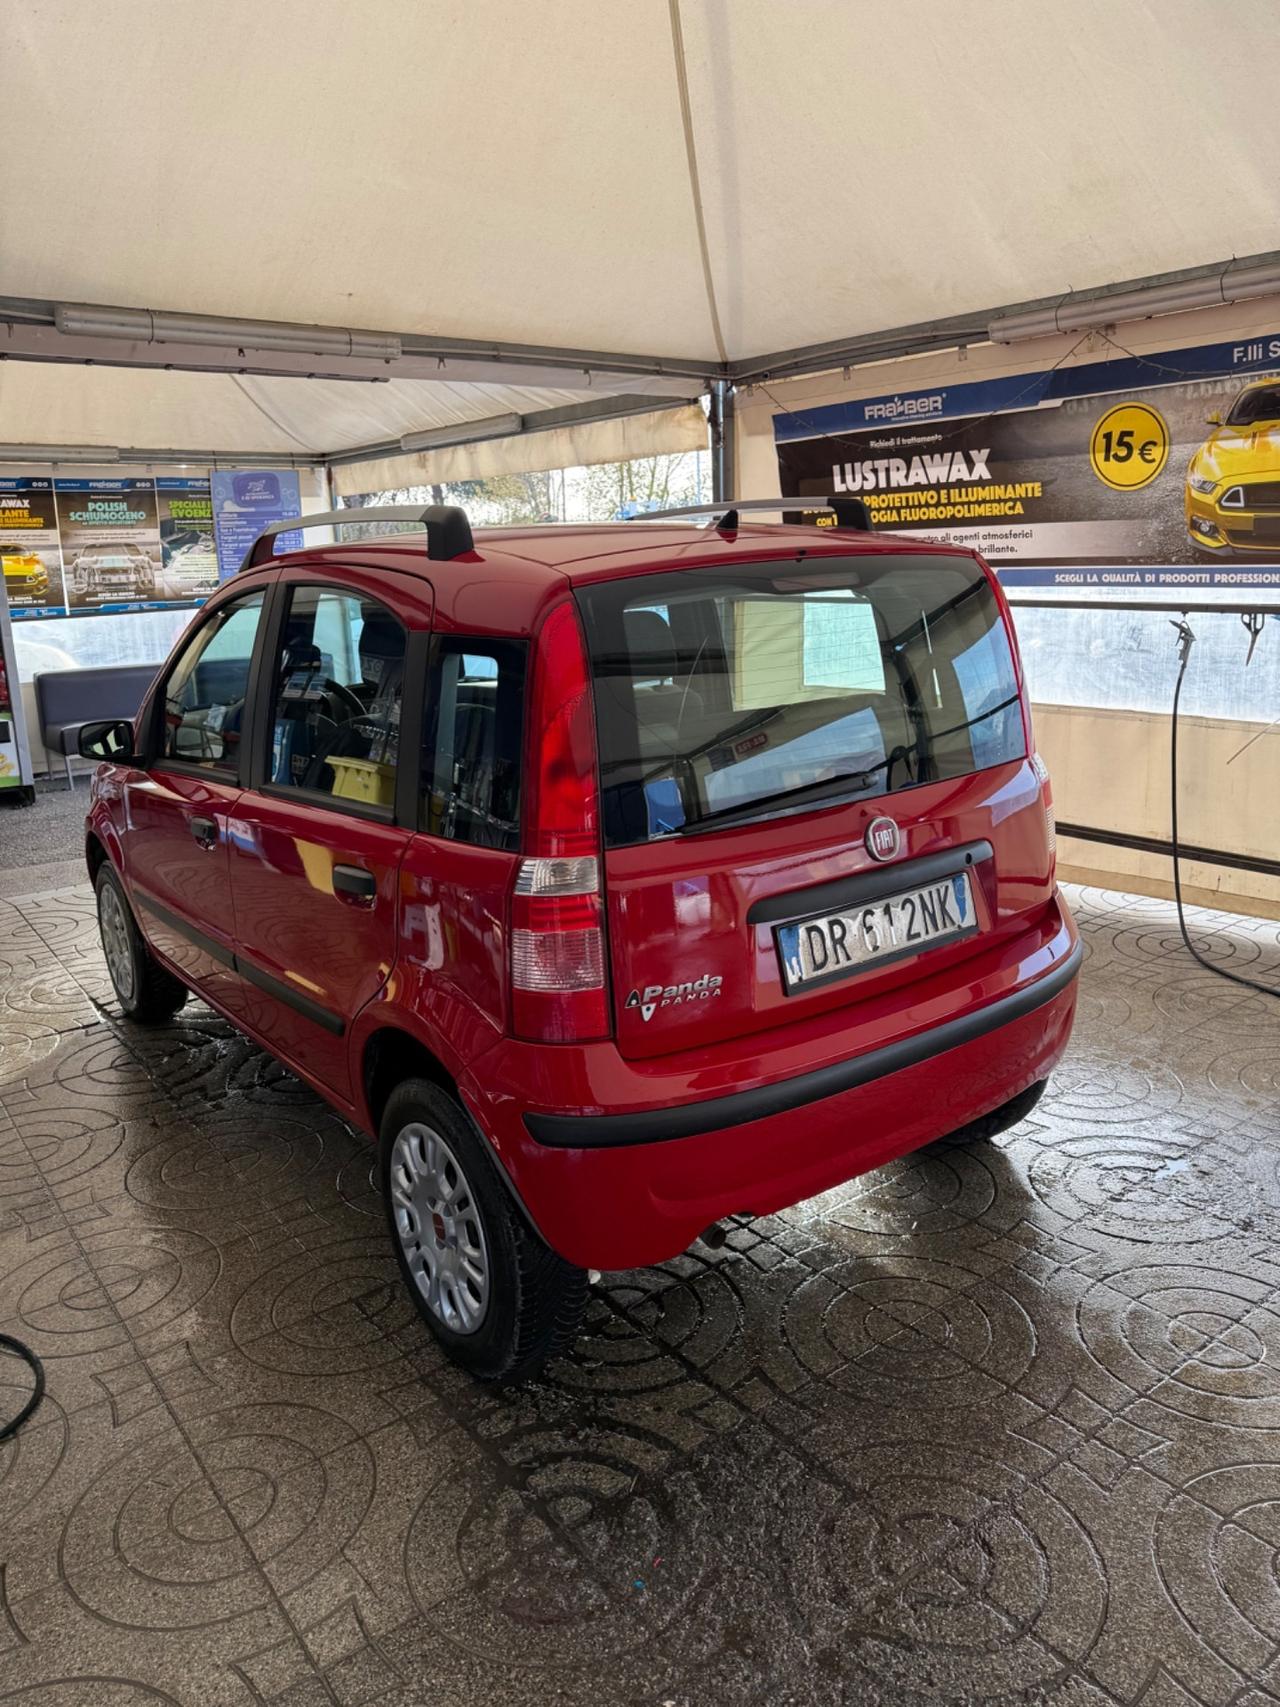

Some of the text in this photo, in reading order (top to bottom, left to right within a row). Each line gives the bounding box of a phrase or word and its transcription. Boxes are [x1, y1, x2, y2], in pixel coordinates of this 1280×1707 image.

[1233, 343, 1263, 363] F.lli
[902, 433, 943, 445] trattamento
[832, 448, 992, 493] LUSTRAWAX
[941, 490, 949, 503] E
[950, 482, 1042, 503] ILLUMINANTE
[69, 510, 147, 521] SCHIUMOGENO
[87, 501, 128, 512] POLISH
[901, 501, 1025, 521] FLUOROPOLIMERICA
[952, 531, 980, 543] agenti
[982, 529, 1033, 540] atmosferici
[978, 544, 1018, 554] brillante.
[1055, 573, 1084, 583] SCEGLI
[1087, 573, 1099, 583] LA
[1102, 571, 1141, 583] QUALITÀ
[1145, 573, 1156, 583] DI
[1159, 573, 1210, 583] PRODOTTI
[875, 828, 894, 850] FIAT
[805, 917, 851, 972] DR
[643, 974, 723, 1003] Panda
[660, 988, 721, 1008] PANDA
